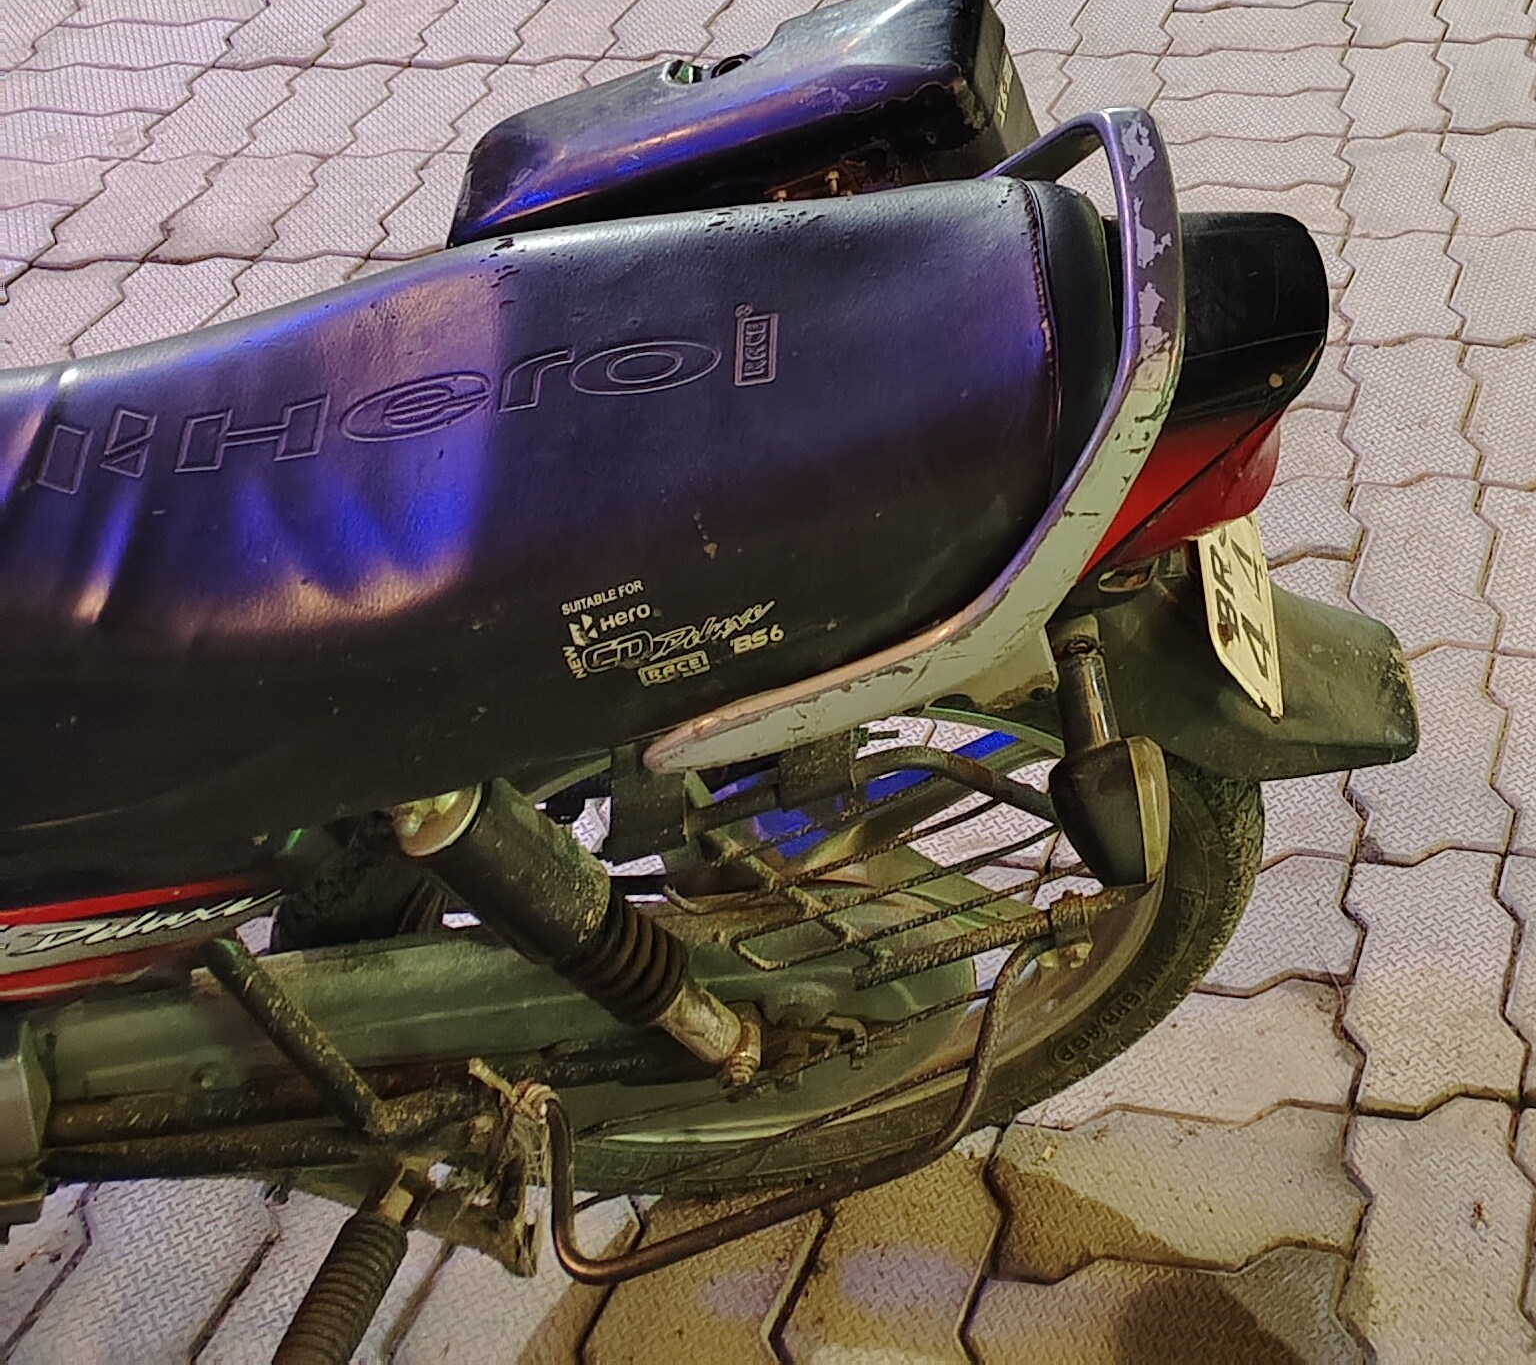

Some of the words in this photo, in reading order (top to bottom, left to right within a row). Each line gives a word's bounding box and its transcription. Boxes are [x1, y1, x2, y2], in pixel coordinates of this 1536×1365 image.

[562, 589, 619, 616] SUITABLE
[618, 580, 645, 599] FOR
[563, 646, 588, 679] NEW
